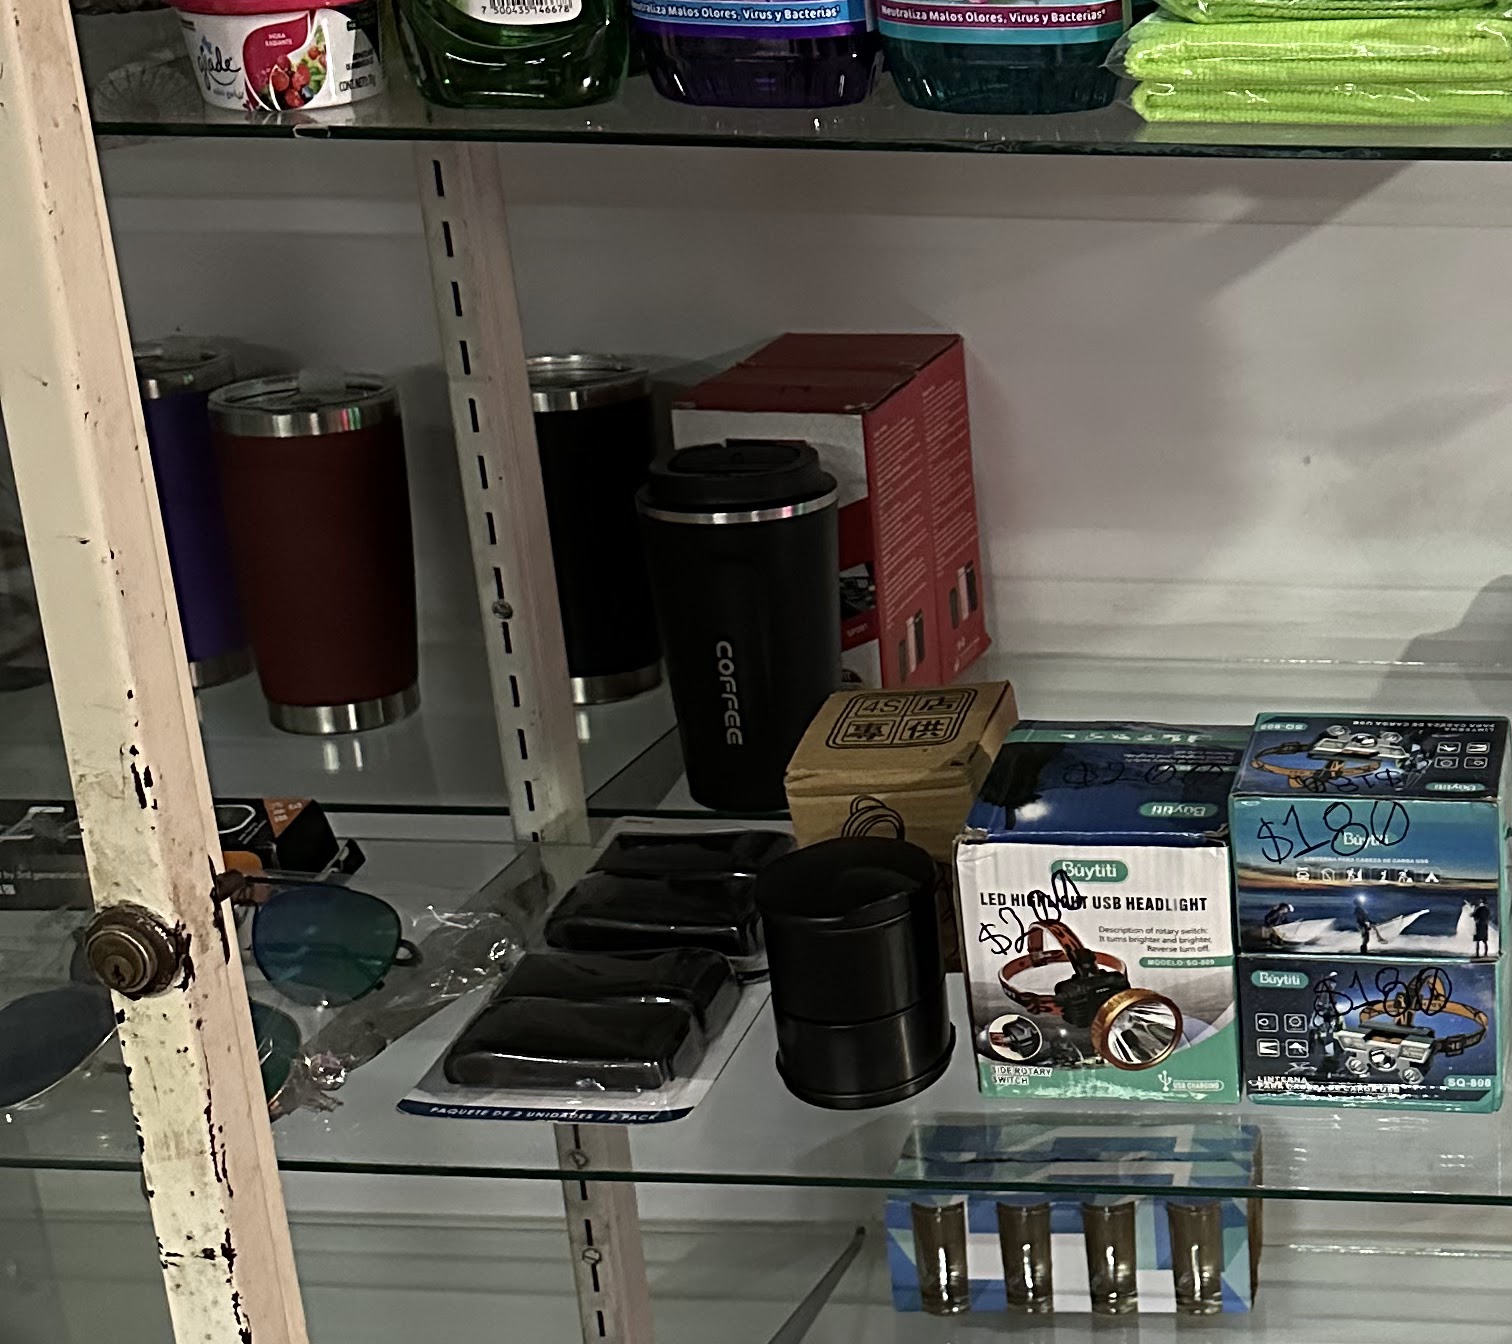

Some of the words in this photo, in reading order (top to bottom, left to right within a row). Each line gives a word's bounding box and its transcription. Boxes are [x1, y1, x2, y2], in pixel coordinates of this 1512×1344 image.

[928, 8, 963, 22] Malos
[1009, 10, 1040, 25] Virus
[715, 639, 744, 746] COFFEE
[1257, 800, 1410, 864] $180
[980, 892, 1006, 906] LED
[1092, 895, 1122, 910] USB
[1126, 896, 1208, 912] HEADLIGHT
[1098, 926, 1143, 937] Description
[1313, 966, 1452, 1018] $180
